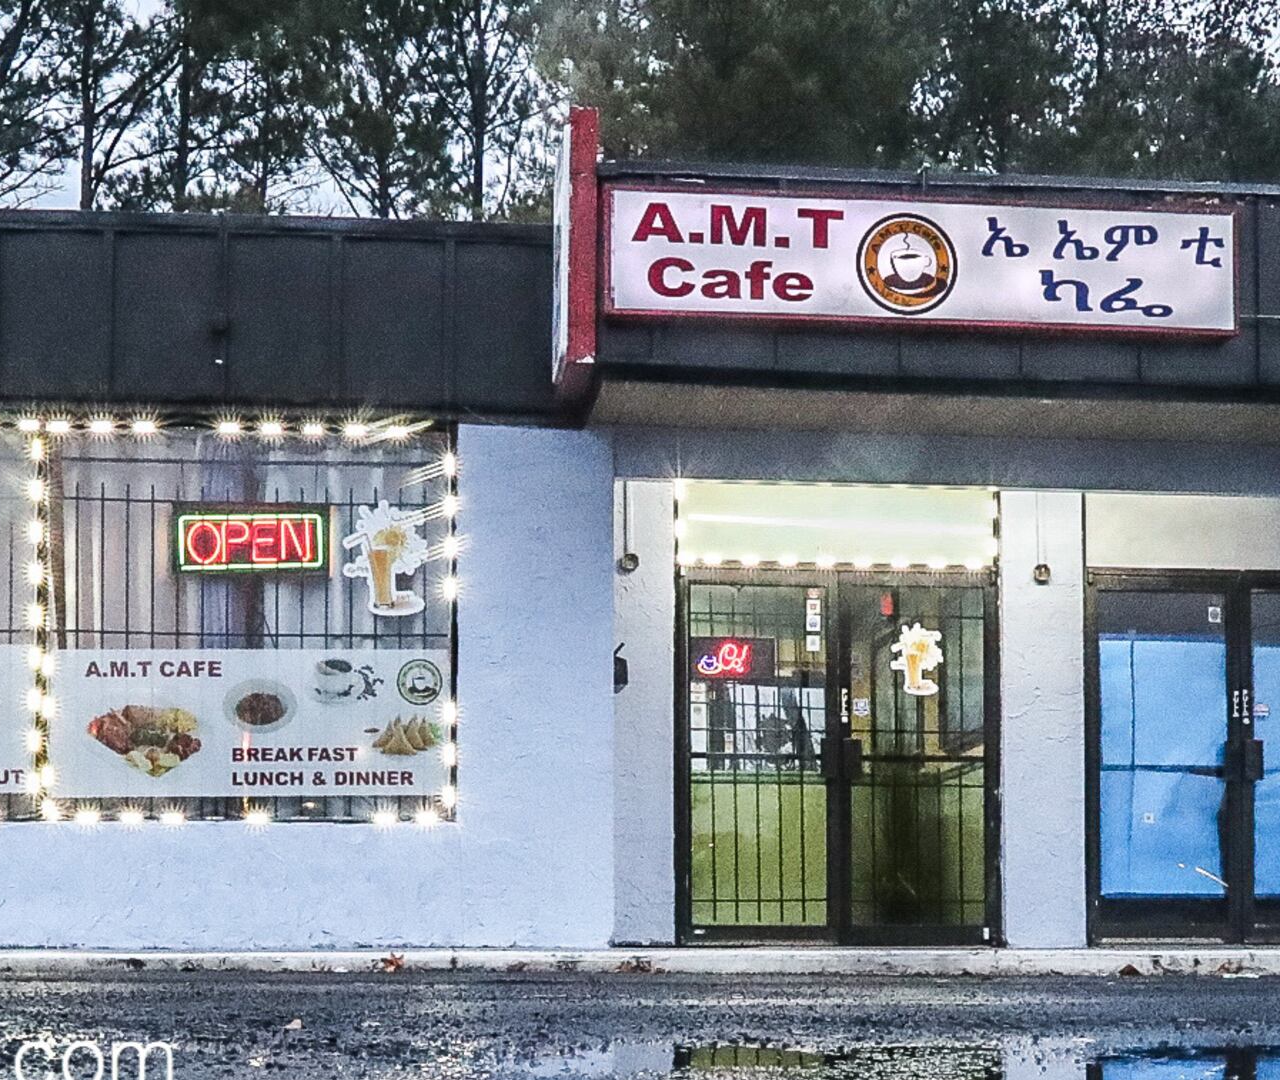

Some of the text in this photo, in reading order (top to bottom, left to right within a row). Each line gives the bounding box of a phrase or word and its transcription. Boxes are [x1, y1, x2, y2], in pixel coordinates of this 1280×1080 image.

[631, 201, 845, 250] A.M.T
[981, 216, 1225, 268] ኤ ኤም ቲ
[647, 256, 815, 302] Cafe
[1038, 269, 1174, 318] ካፌ
[187, 518, 313, 564] OPEN
[85, 661, 222, 677] A.M.T CAFE
[232, 771, 414, 786] LUNCH & DINNER
